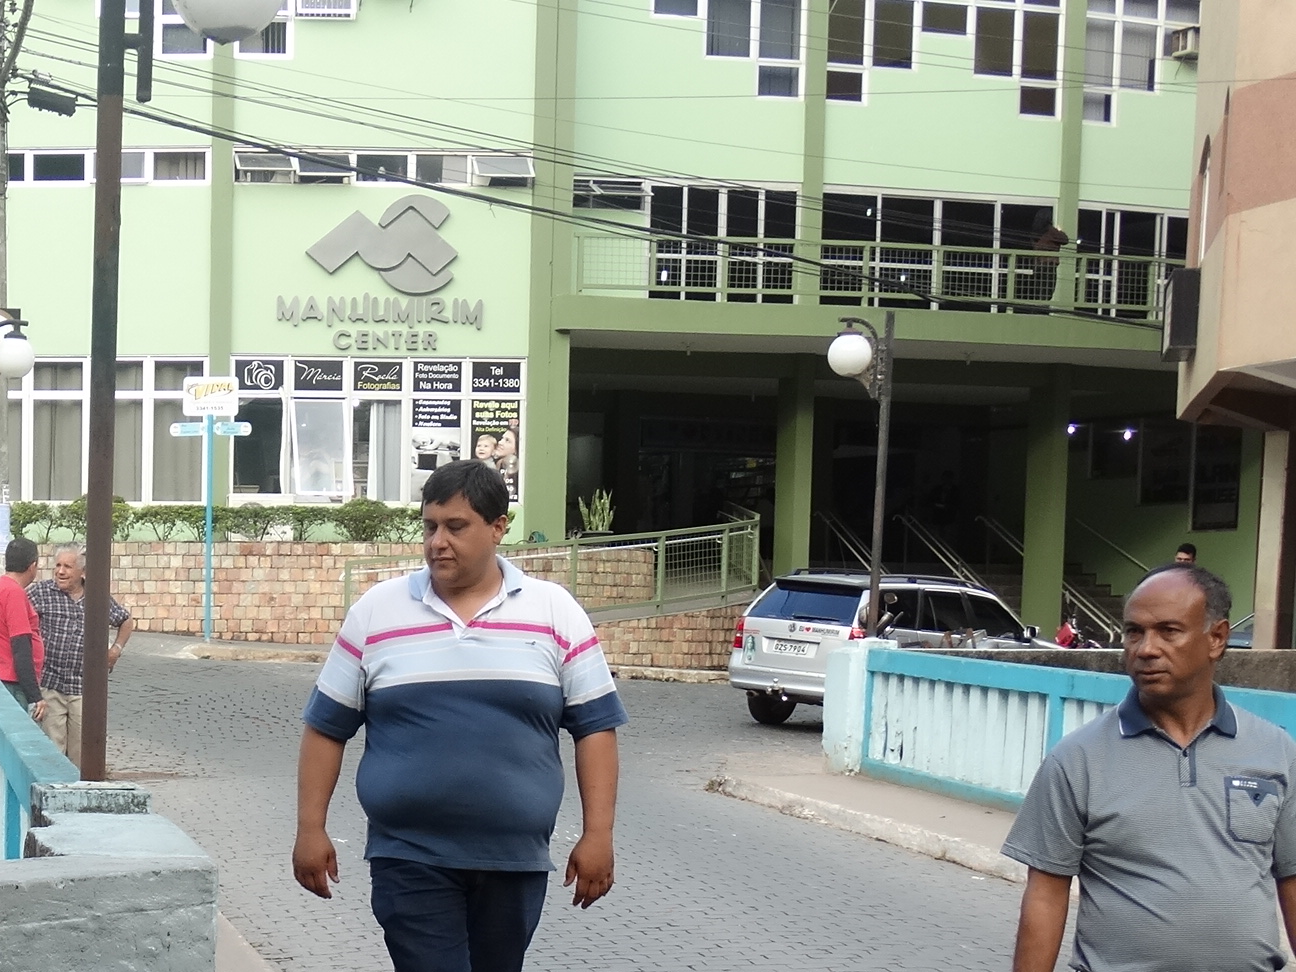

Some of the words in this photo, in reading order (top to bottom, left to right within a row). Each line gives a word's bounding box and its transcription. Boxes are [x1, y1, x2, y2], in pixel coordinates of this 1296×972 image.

[276, 292, 484, 330] MANHUMIRIM
[332, 329, 438, 351] CENTER
[296, 361, 342, 385] Márcia
[357, 364, 400, 382] Rocha
[417, 363, 459, 373] Revelação
[490, 366, 504, 376] Tel
[357, 381, 401, 391] Fotografias
[419, 381, 432, 390] Na
[433, 381, 453, 390] Hora
[472, 378, 520, 388] 3341-1380
[501, 401, 518, 410] aqui
[495, 410, 518, 418] Fotos
